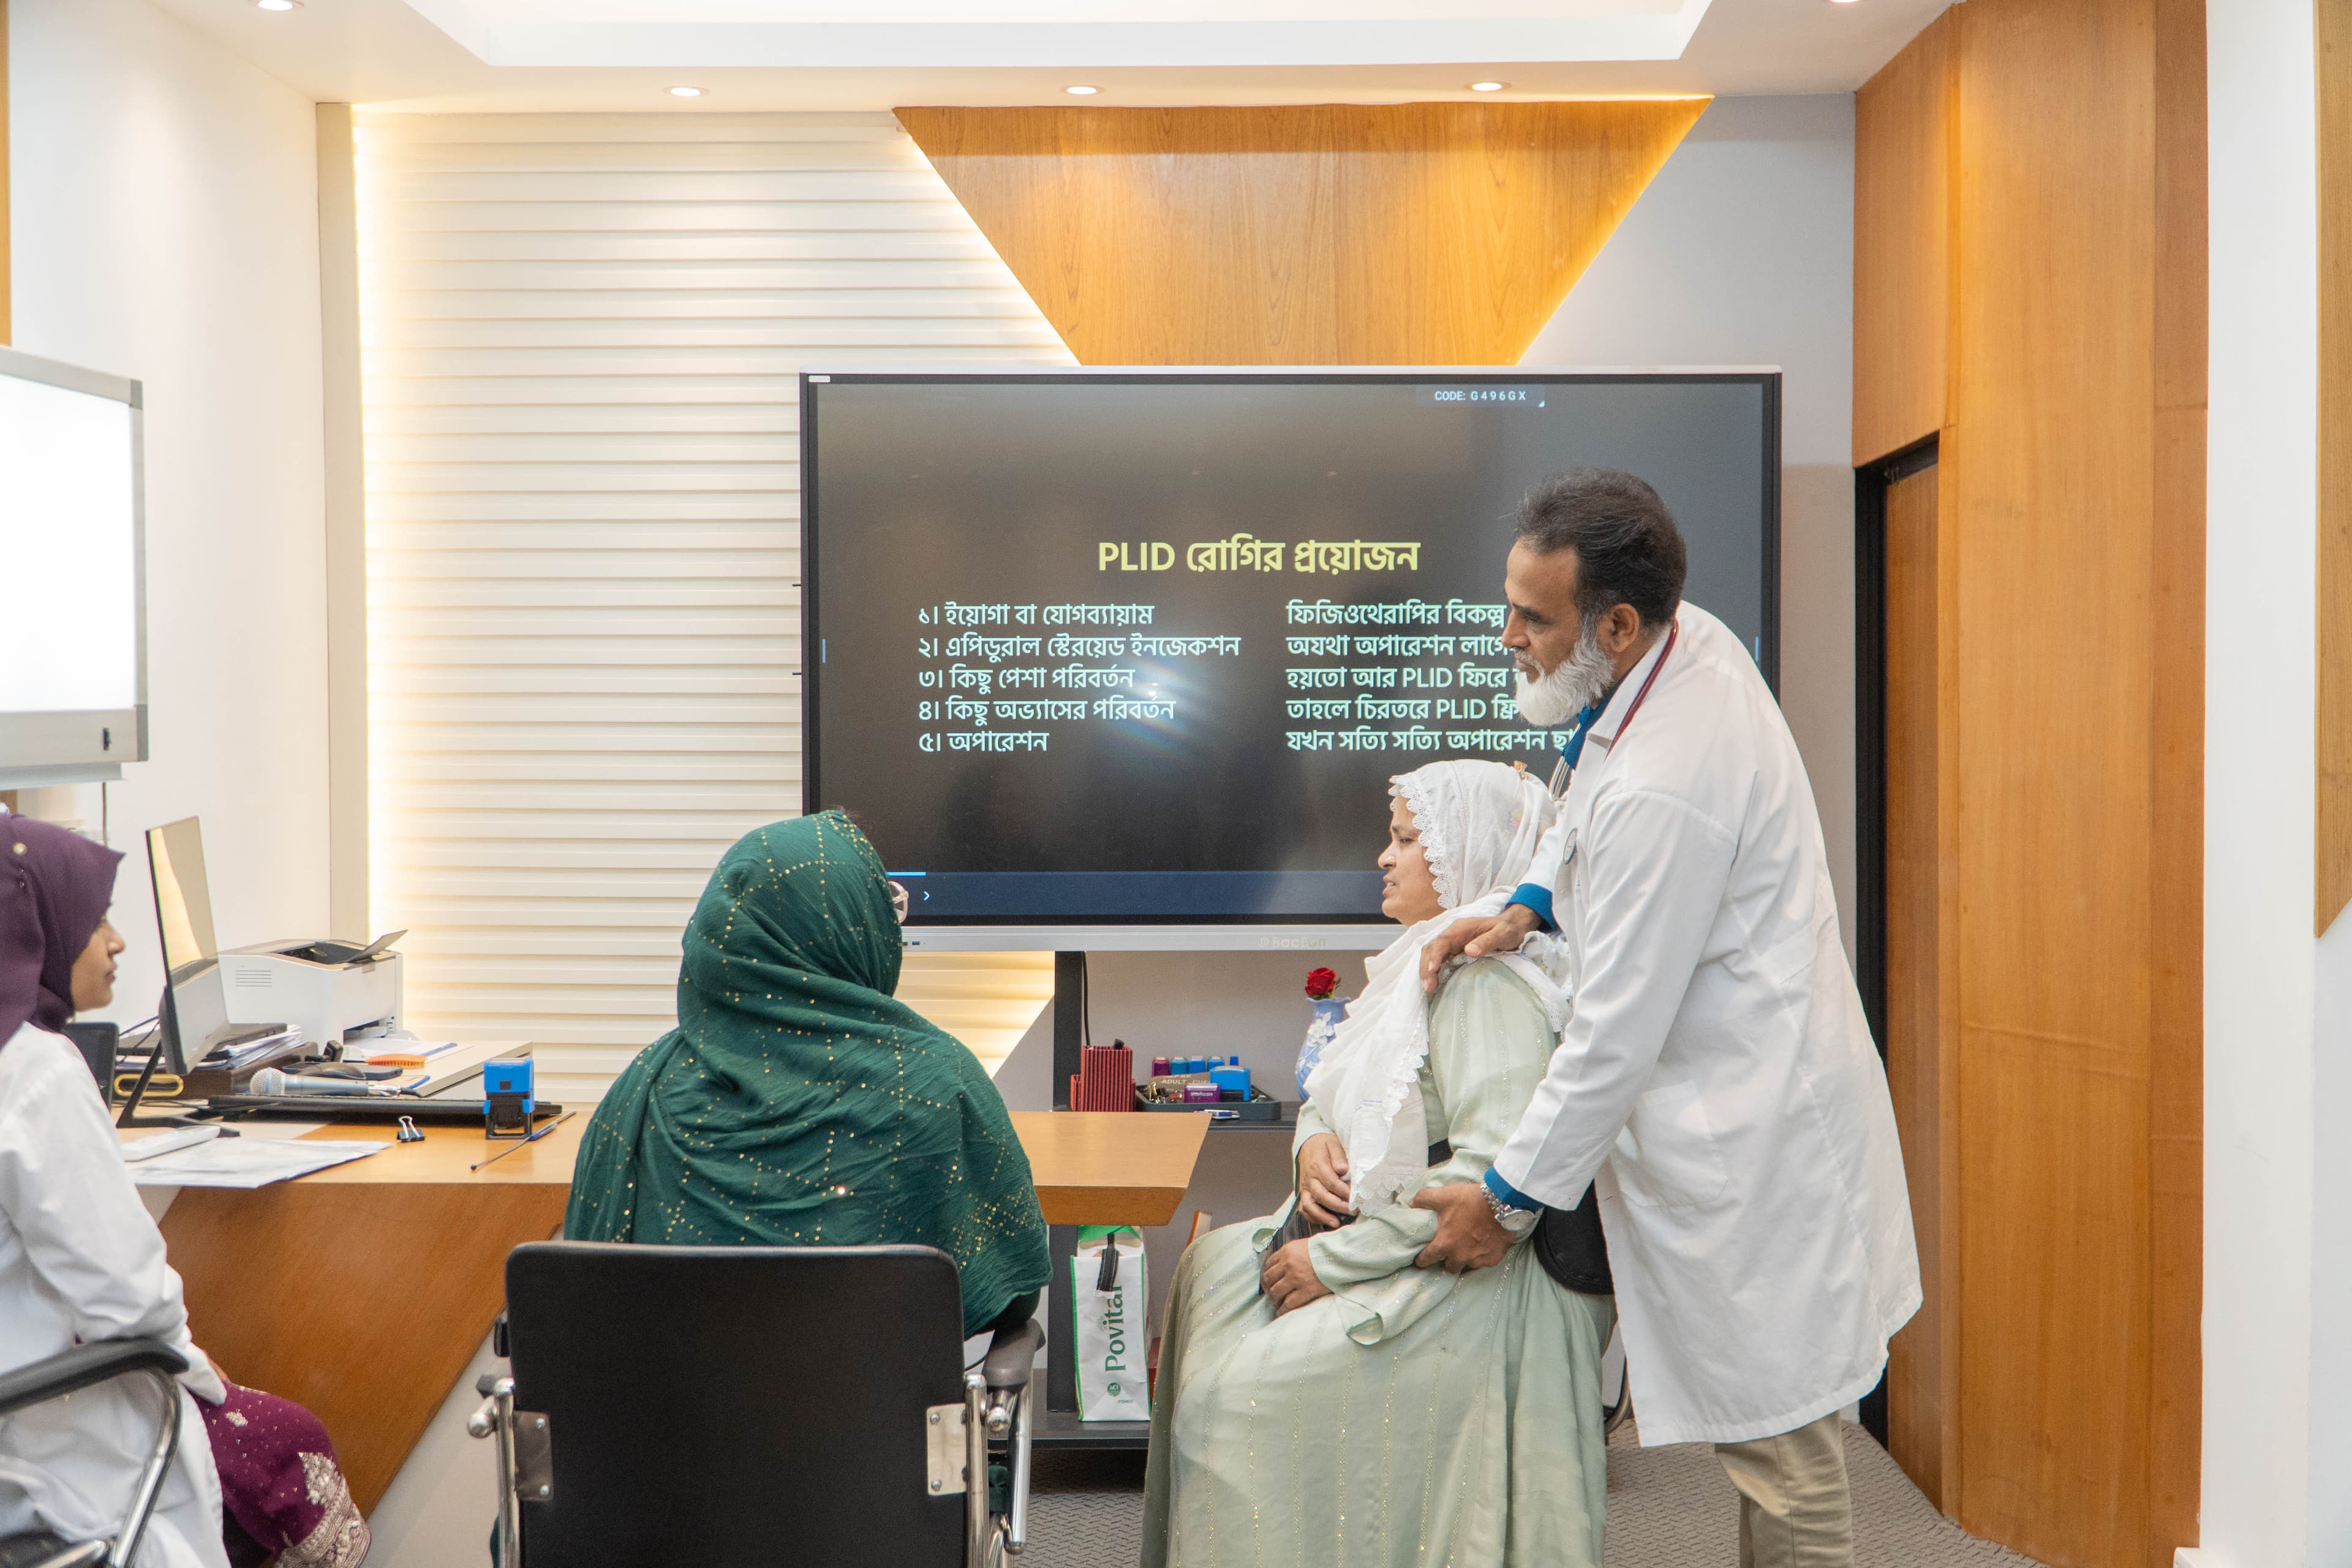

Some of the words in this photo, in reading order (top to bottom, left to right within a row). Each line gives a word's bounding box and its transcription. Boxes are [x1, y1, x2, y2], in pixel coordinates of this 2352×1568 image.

[1434, 390, 1466, 401] CODE:
[1099, 542, 1175, 571] PLID
[1186, 532, 1286, 573] রোগির
[1294, 539, 1421, 575] প্রয়োজন
[918, 606, 938, 625] ১।
[944, 601, 1011, 627] ইয়োগা
[1014, 603, 1038, 625] বা
[1042, 603, 1155, 627] যোগব্যায়াম
[1285, 598, 1442, 625] ফিজিওথেরাপির
[1445, 598, 1507, 628] বিকল্প
[918, 638, 938, 658] ২।
[945, 631, 1042, 663] এপিডুরাল
[1047, 632, 1126, 658] স্টেরয়েড
[1129, 632, 1242, 657] ইনজেকশন
[1286, 635, 1351, 656] অযথা
[1353, 634, 1457, 657] অপারেশন
[919, 669, 943, 688] ৩।
[948, 663, 993, 696] কিছু
[998, 667, 1047, 688] পেশা
[1052, 663, 1135, 689] পরিবর্তন
[1285, 666, 1348, 690] হয়তো
[1350, 666, 1398, 688] আর
[1403, 667, 1453, 688] PLID
[1457, 662, 1509, 688] ফিরে
[919, 701, 939, 720] ৪।
[944, 693, 990, 726] কিছু
[993, 698, 1088, 720] অভ্যাসের
[1093, 693, 1177, 720] পরিবর্তন
[1285, 698, 1352, 720] তাহলে
[1354, 693, 1432, 720] চিরতরে
[1436, 698, 1487, 719] PLID
[919, 733, 941, 752] ৫।
[946, 730, 1050, 752] অপারেশন
[1286, 729, 1335, 751] যখন
[1338, 725, 1389, 751] সত্যি
[1391, 725, 1443, 750] সত্যি
[1445, 728, 1548, 751] অপারেশন
